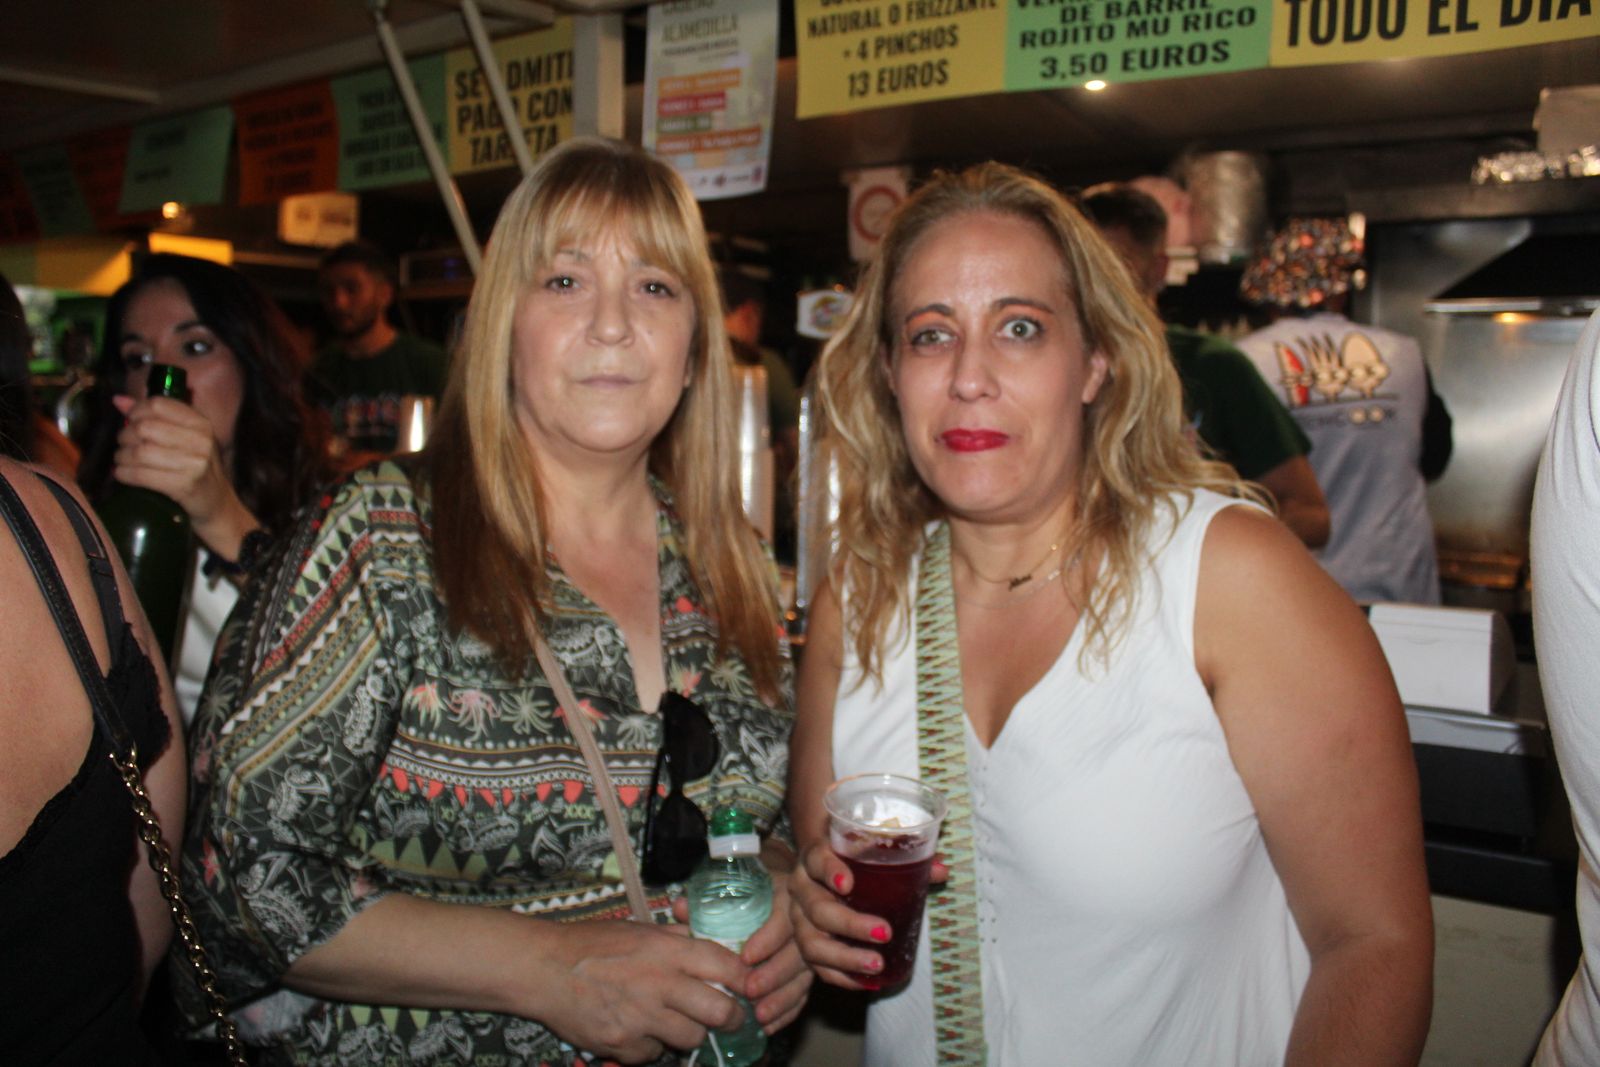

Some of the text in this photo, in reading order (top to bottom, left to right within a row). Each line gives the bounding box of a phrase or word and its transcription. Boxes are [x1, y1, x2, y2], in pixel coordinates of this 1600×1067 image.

[808, 9, 882, 37] NATURAL
[888, 3, 900, 26] O
[1019, 6, 1256, 49] ROJITO MU RICO
[1061, 5, 1093, 24] DE
[1283, 0, 1407, 47] TODO
[1427, 0, 1479, 35] EL
[857, 40, 869, 60] 4
[875, 24, 958, 55] PINCHOS
[1121, 39, 1231, 72] EUROS
[456, 50, 573, 98] SE DMIT
[847, 60, 949, 98] 13 EUROS
[457, 94, 520, 135] PAG
[470, 123, 557, 165] TARETA
